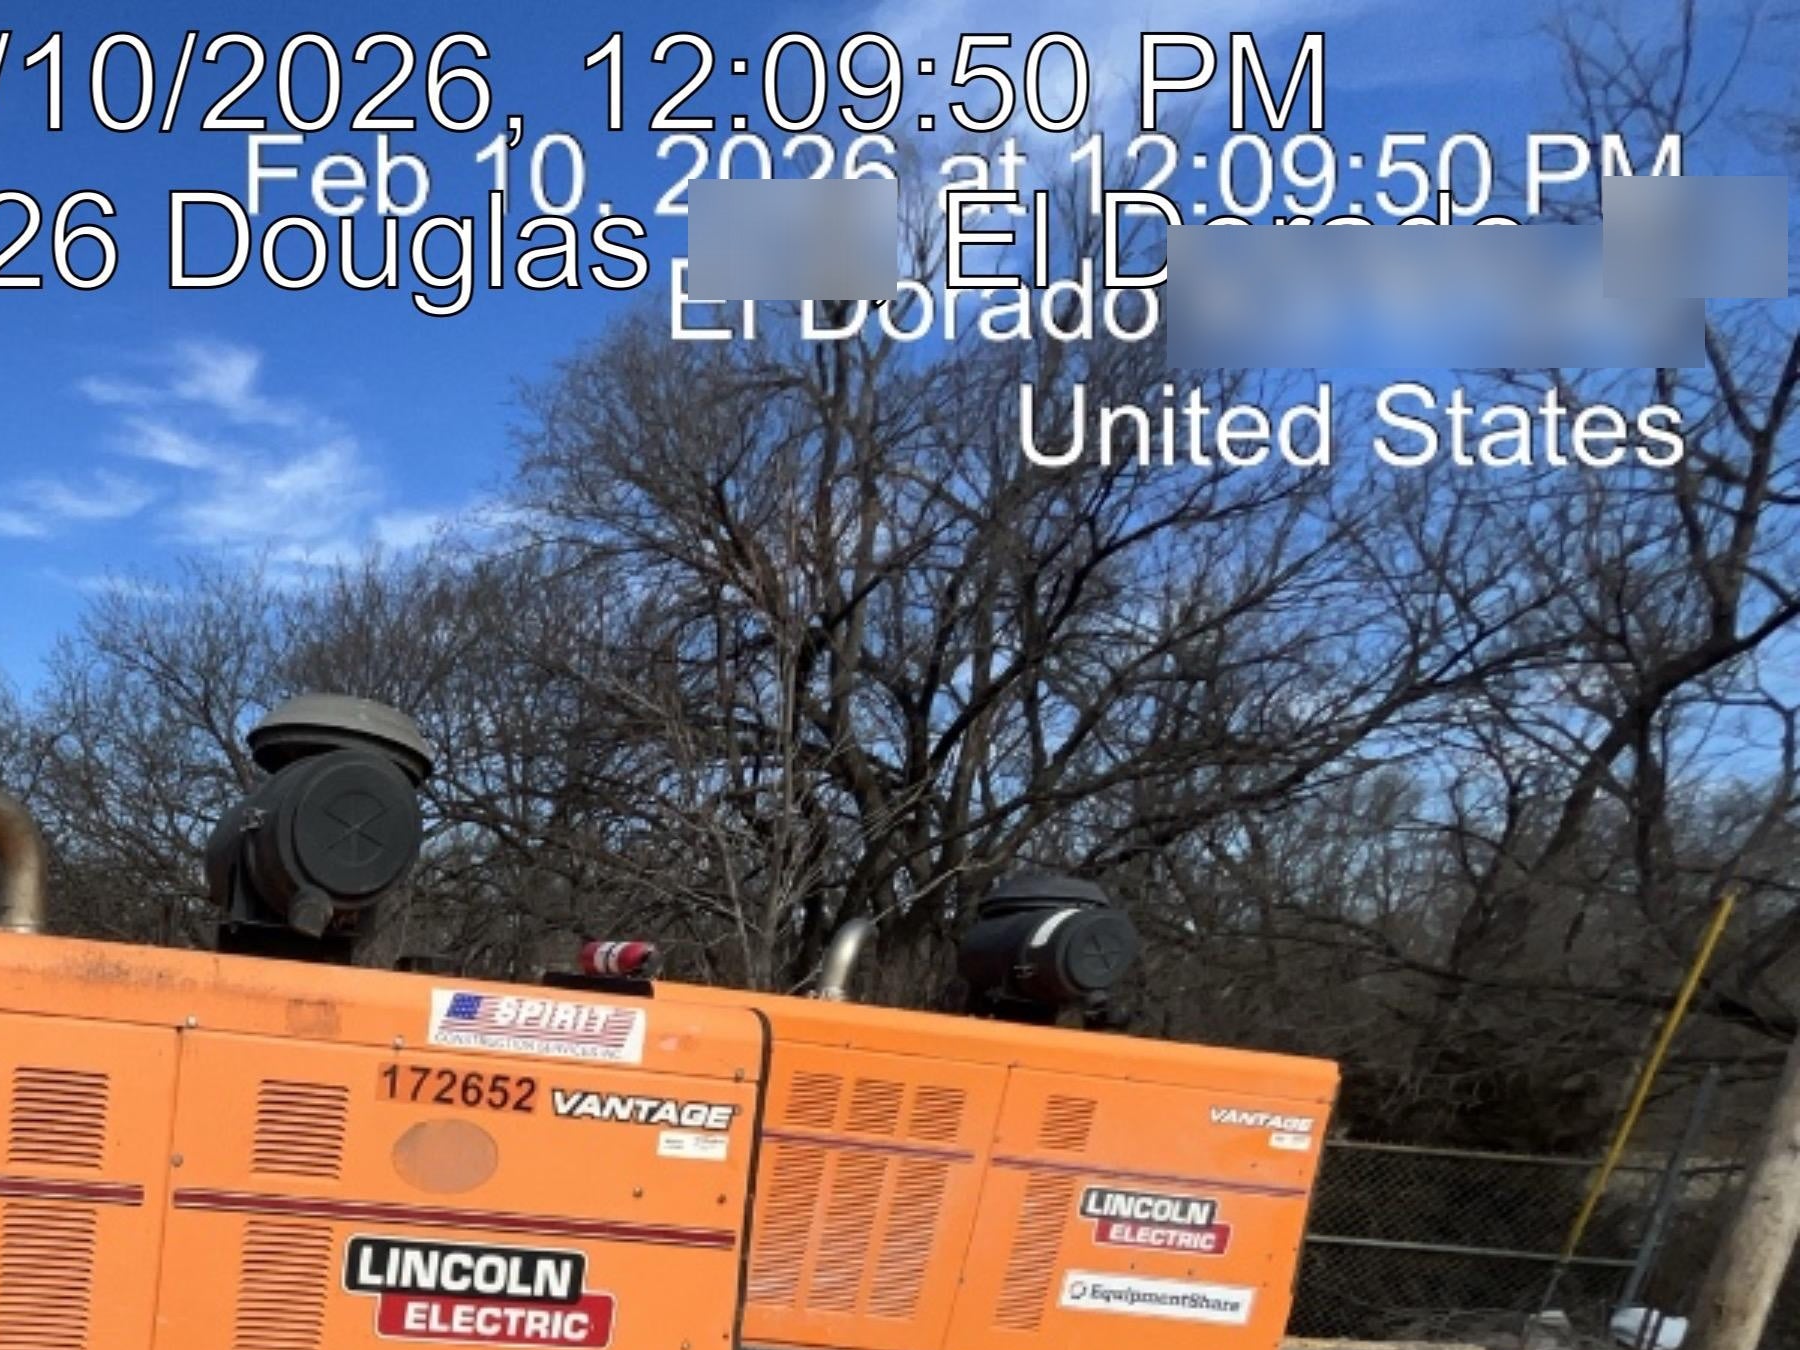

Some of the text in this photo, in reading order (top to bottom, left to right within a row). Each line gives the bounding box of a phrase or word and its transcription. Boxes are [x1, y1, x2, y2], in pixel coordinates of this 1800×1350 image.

[495, 996, 610, 1033] SPIRIT
[381, 1063, 538, 1113] 172652
[552, 1089, 736, 1131] VANTAGE
[1210, 1106, 1315, 1132] VANTAGE
[1085, 1189, 1211, 1225] LINCOLN
[1108, 1222, 1217, 1250] ELECTRIC
[357, 1244, 573, 1299] LINCOLN
[1090, 1282, 1241, 1313] EquipmentShare
[403, 1300, 591, 1341] ELECTRIC
